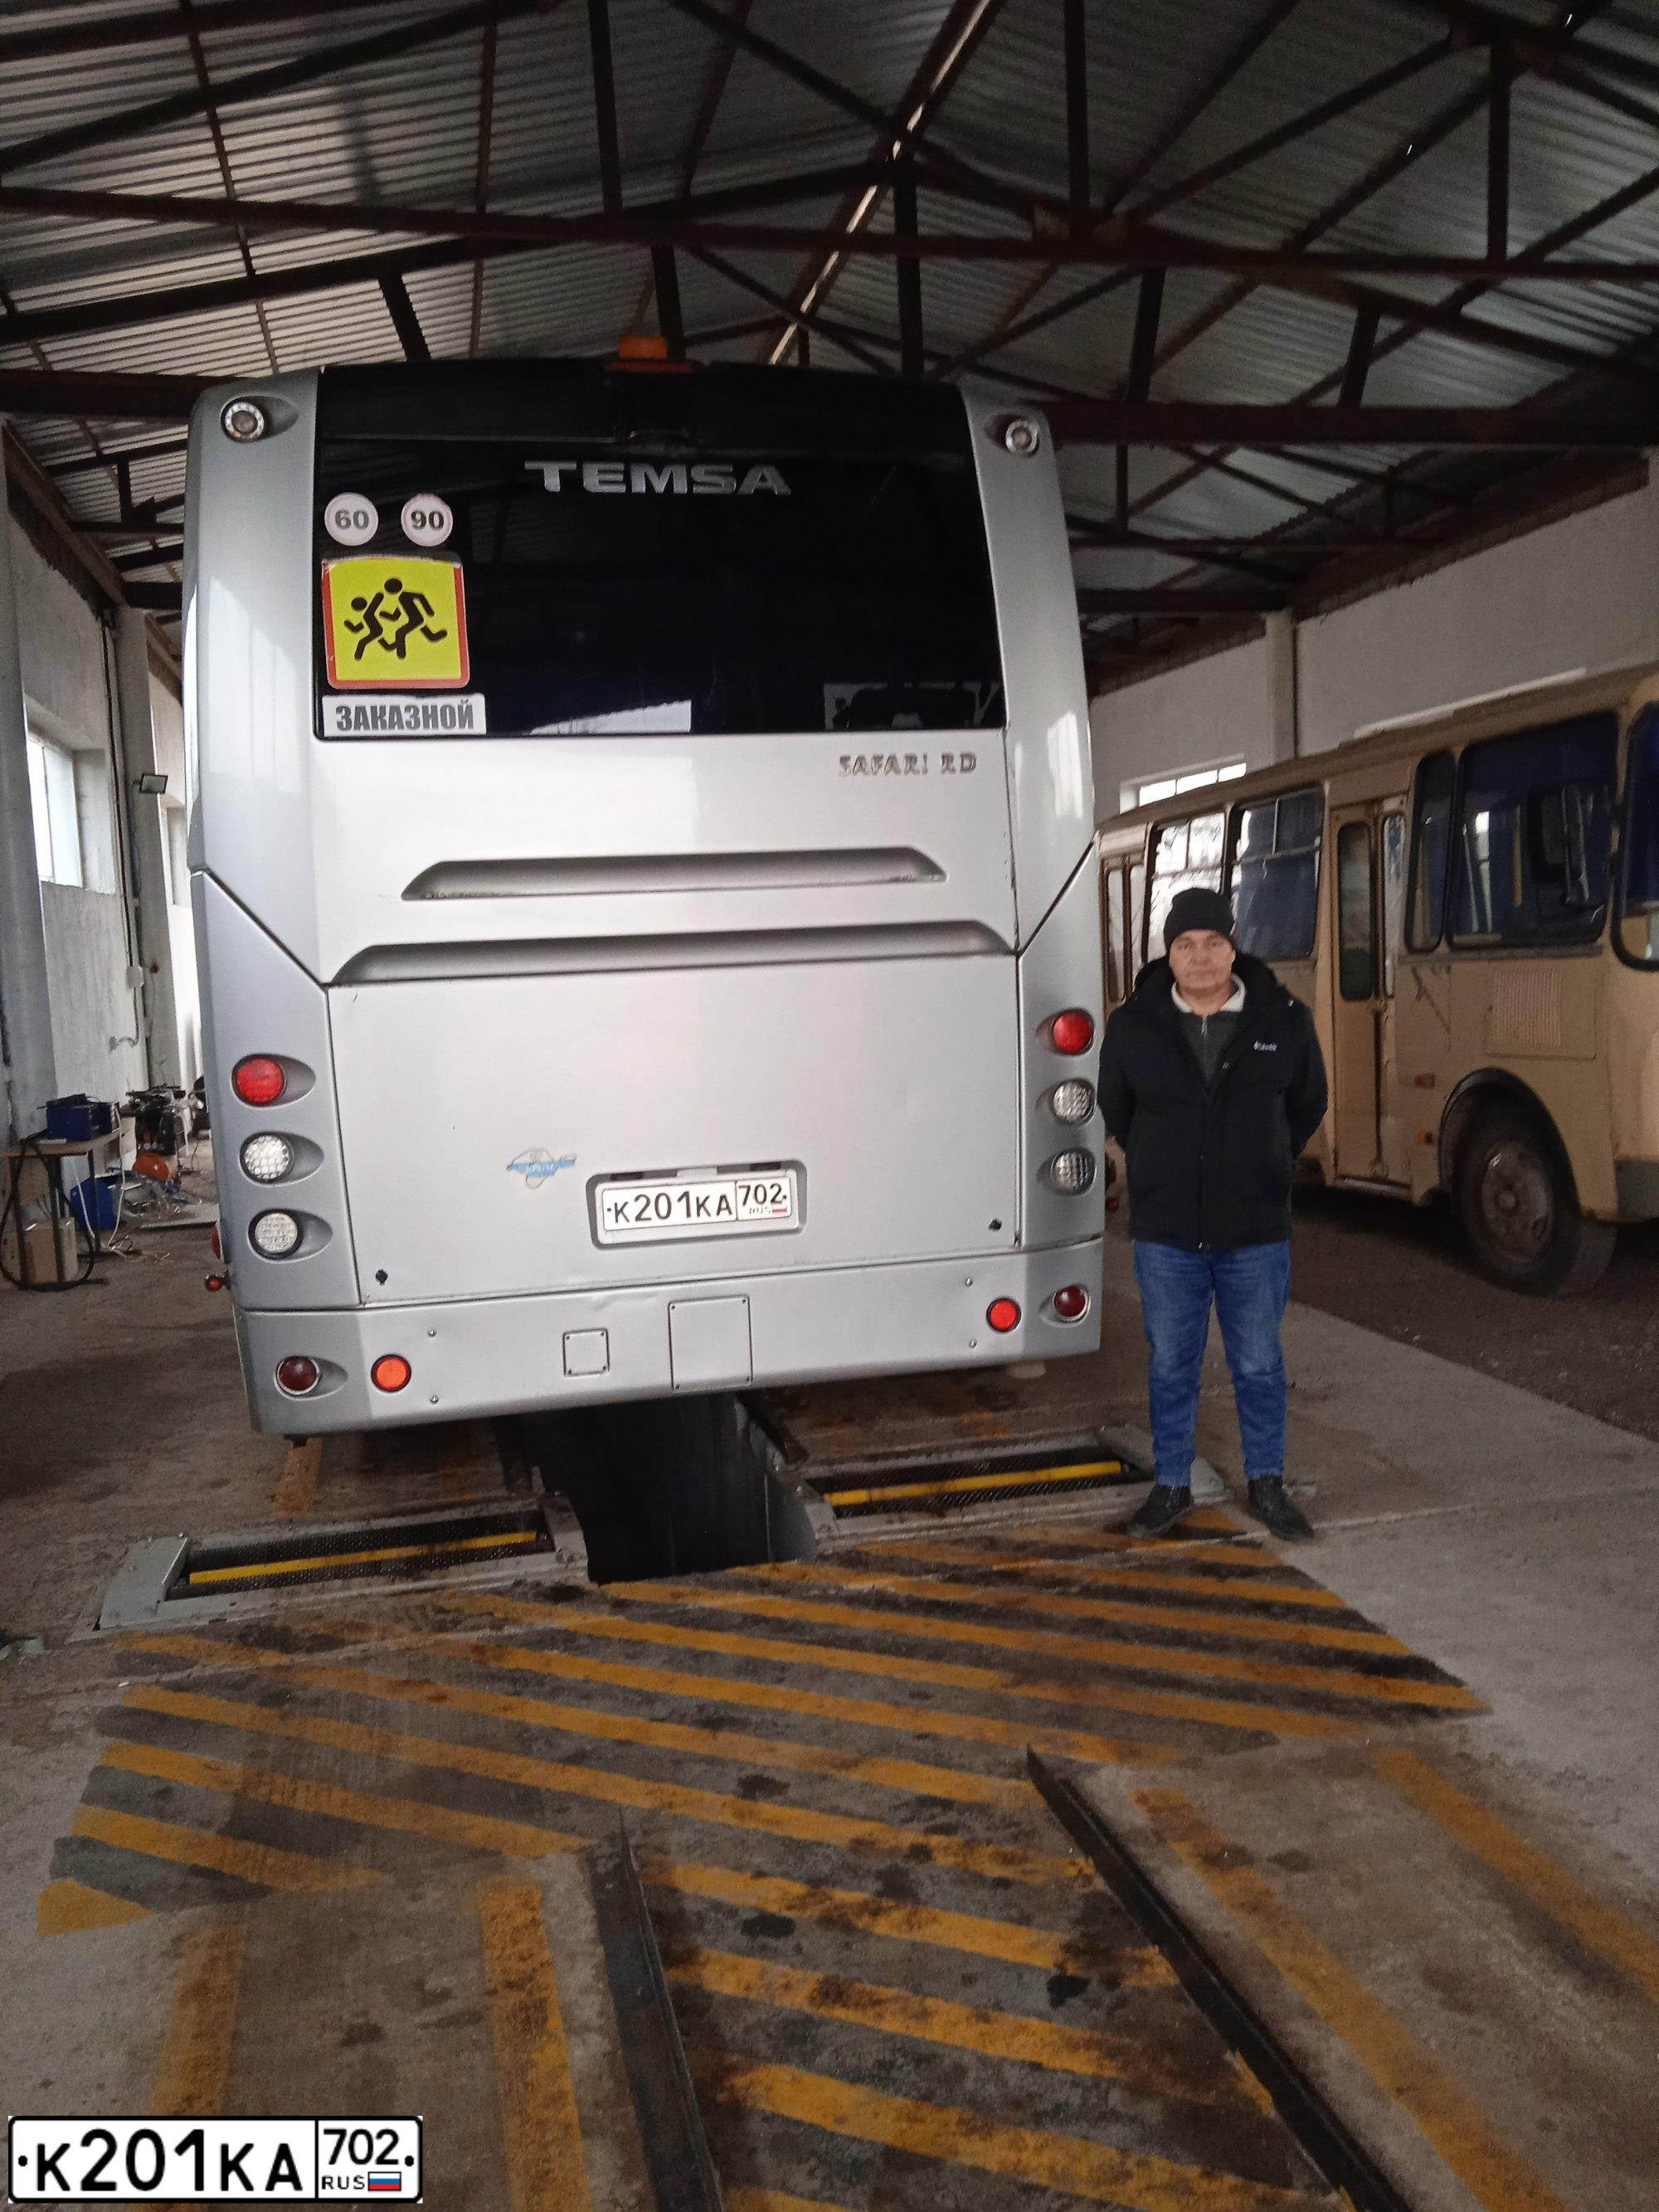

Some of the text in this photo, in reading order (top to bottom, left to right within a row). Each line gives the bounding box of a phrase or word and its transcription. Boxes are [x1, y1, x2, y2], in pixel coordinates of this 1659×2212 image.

[524, 461, 791, 495] TEMSA
[334, 509, 369, 529] 60
[411, 509, 444, 530] 90
[335, 699, 474, 732] ЗАКАЗНОЙ
[839, 753, 927, 777] SAFARI
[614, 1183, 782, 1223] К201КА 702
